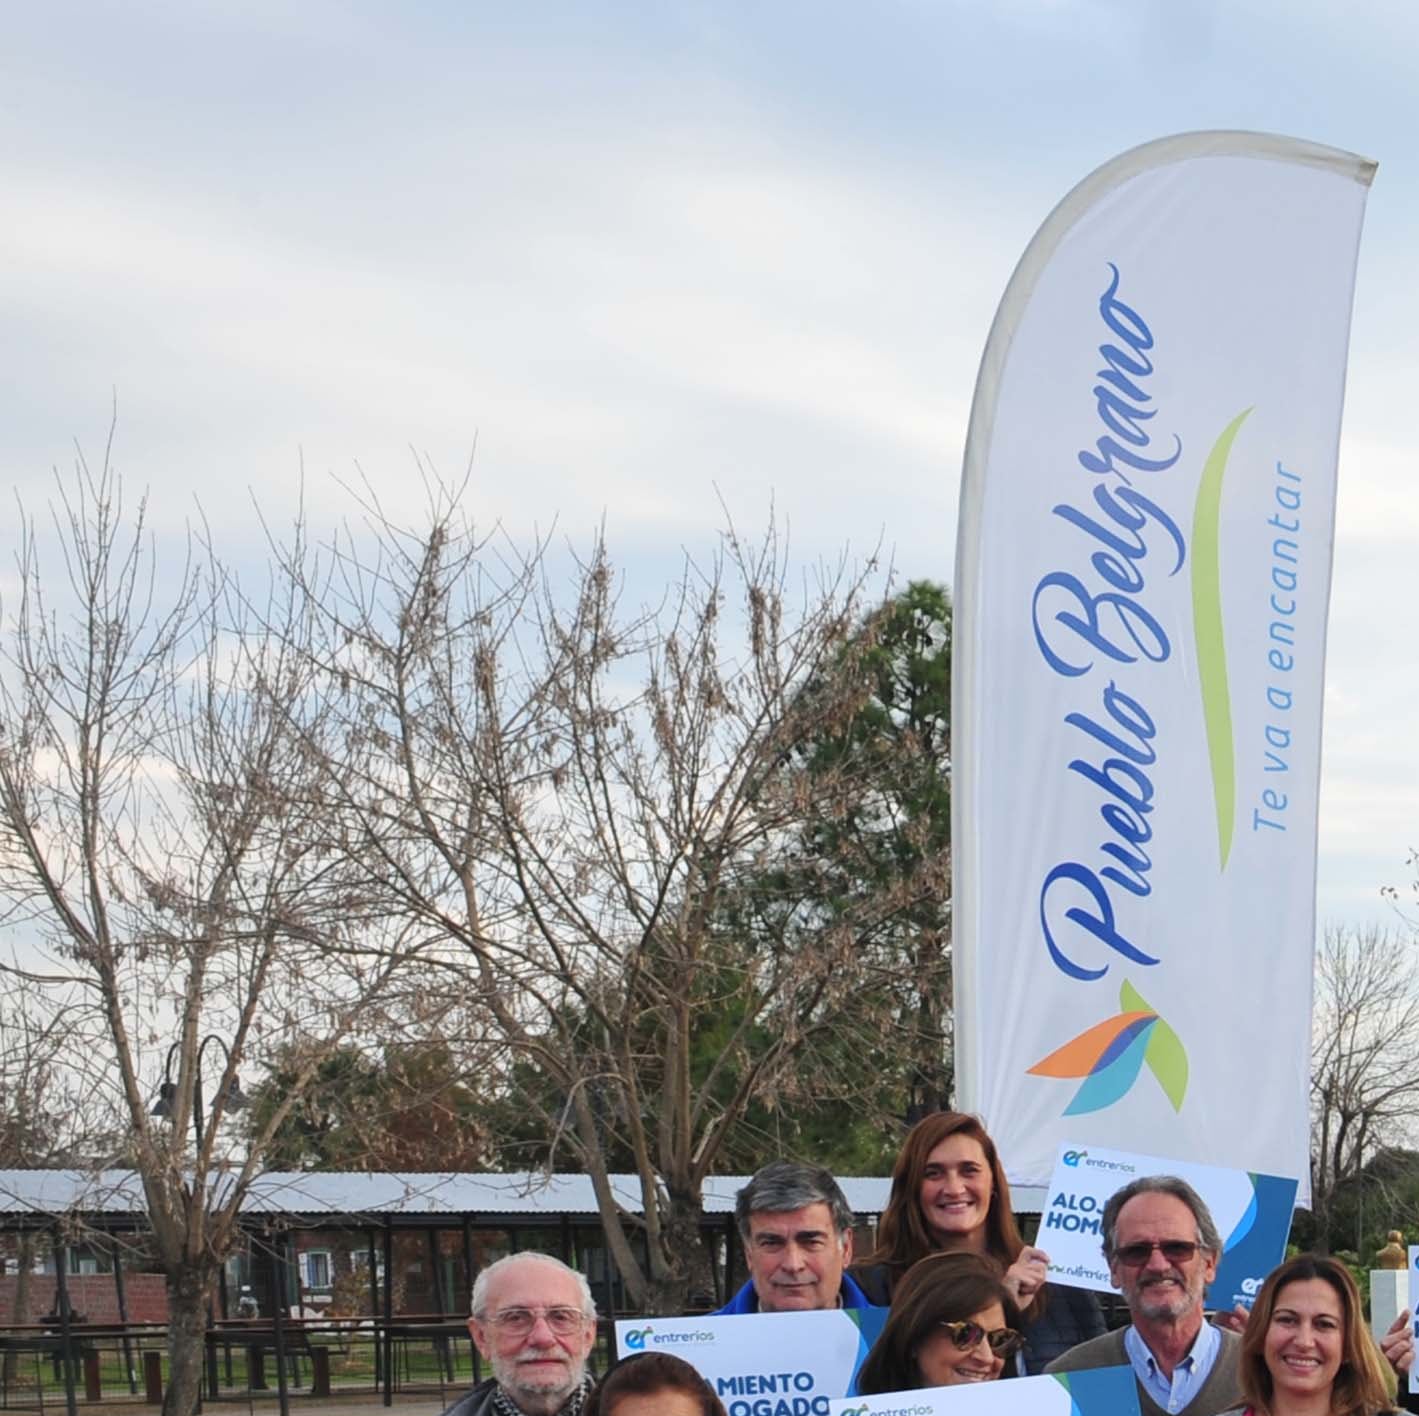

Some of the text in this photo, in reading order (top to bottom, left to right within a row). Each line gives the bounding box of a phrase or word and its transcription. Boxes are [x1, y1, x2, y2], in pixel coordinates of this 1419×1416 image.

[1031, 261, 1187, 983] Pueblo Belgrano
[1252, 460, 1304, 833] Te va a encantar
[717, 1371, 815, 1397] MIENTO
